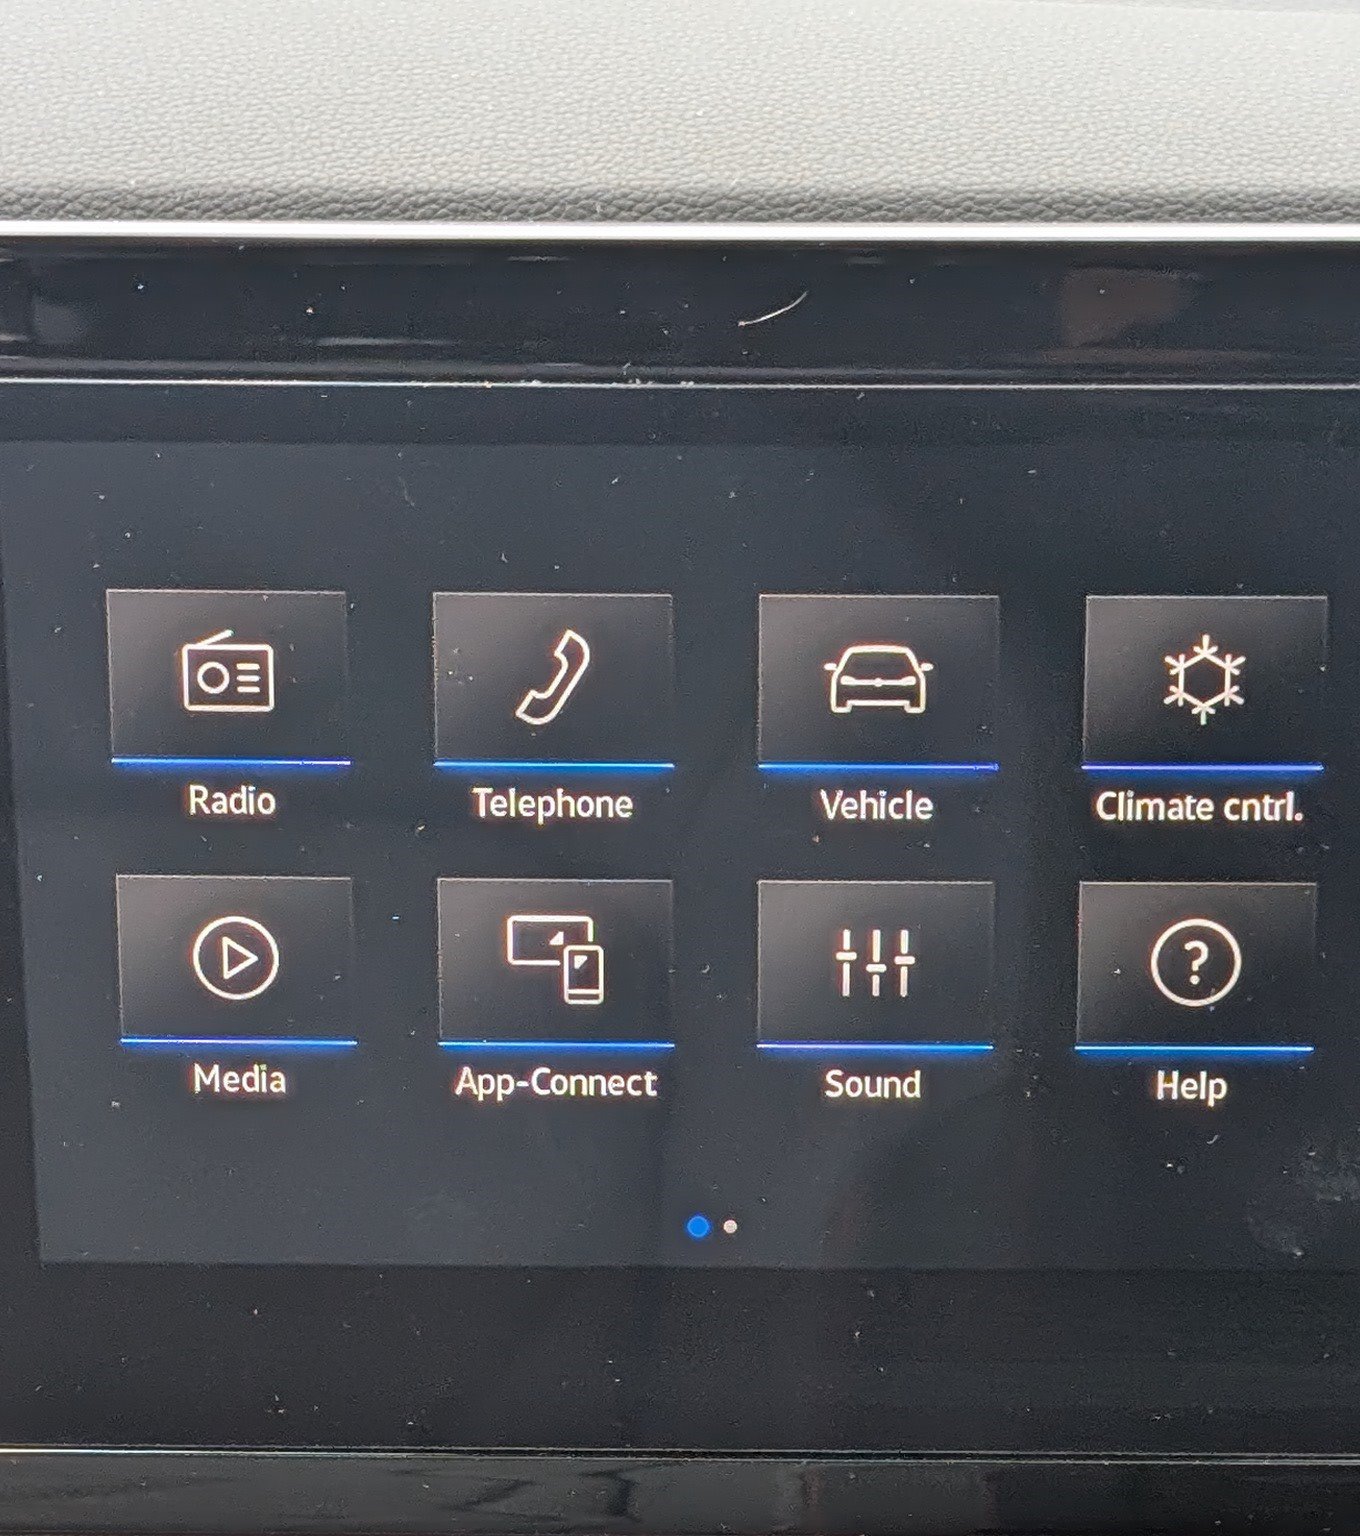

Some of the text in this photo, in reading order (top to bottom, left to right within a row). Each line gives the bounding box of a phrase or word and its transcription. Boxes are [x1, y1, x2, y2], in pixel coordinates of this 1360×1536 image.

[189, 784, 276, 816] Radio
[471, 787, 634, 826] Telephone
[819, 788, 934, 821] Vehicle
[1095, 789, 1304, 822] Climate cntrl.
[193, 1062, 286, 1094] Media
[454, 1065, 659, 1102] App-Connect
[824, 1069, 921, 1099] Sound
[1156, 1069, 1228, 1108] Help
